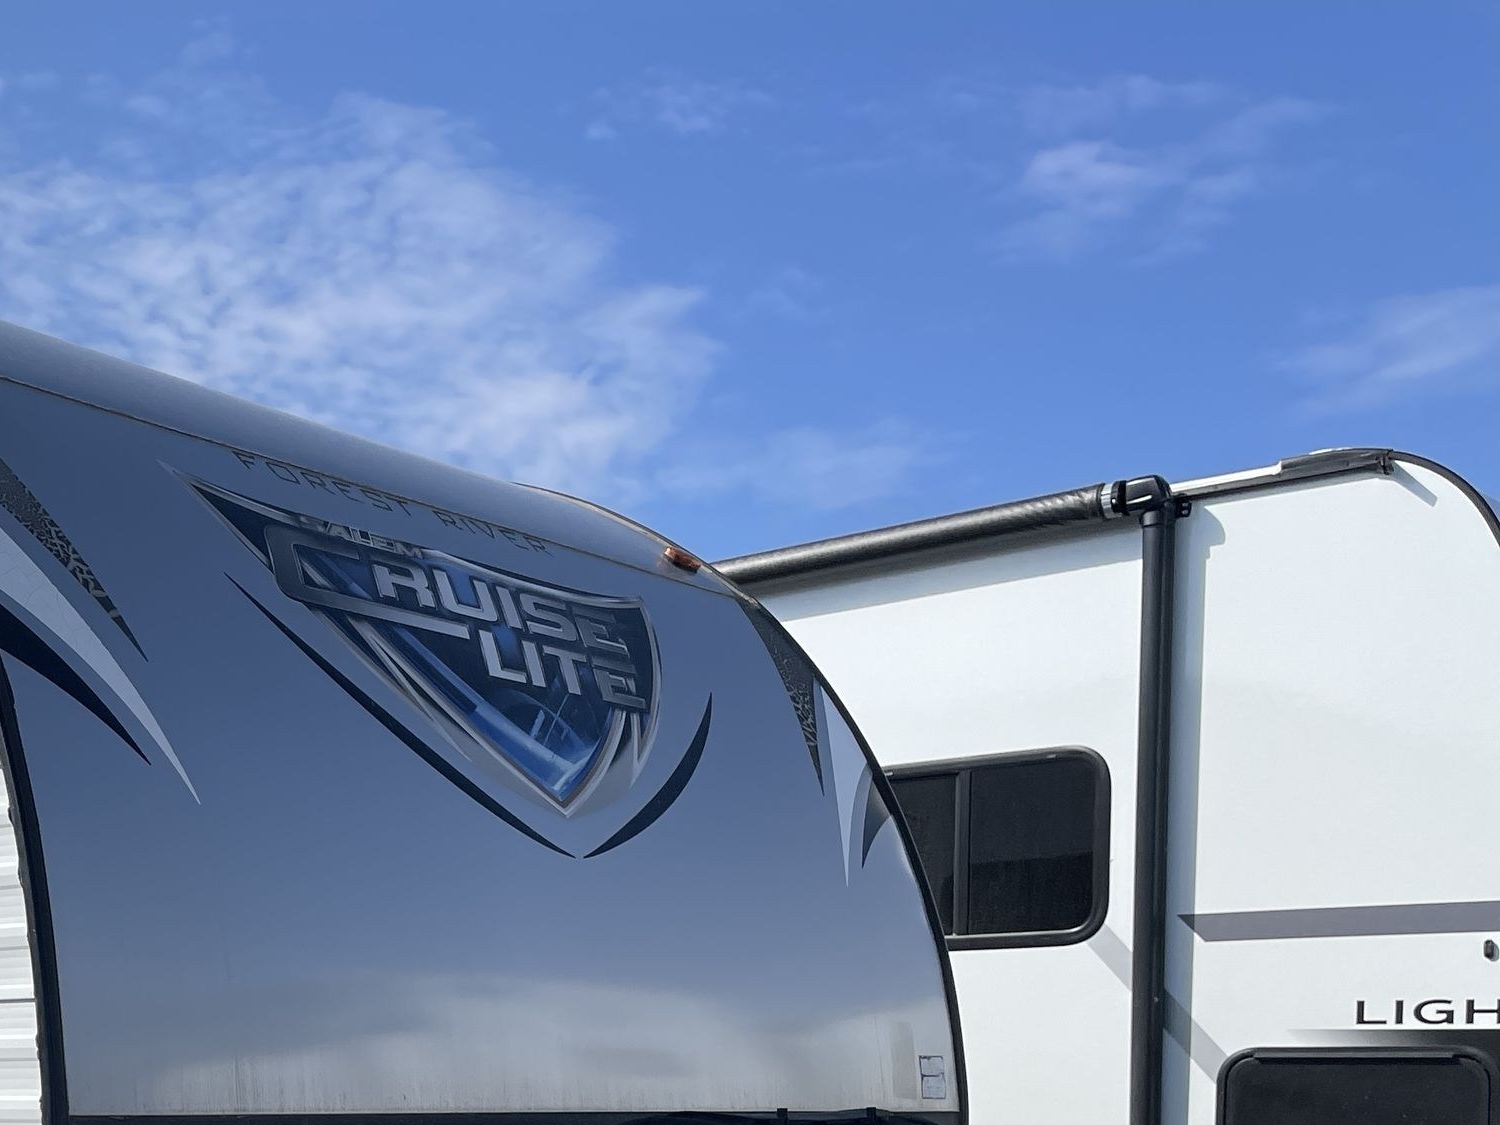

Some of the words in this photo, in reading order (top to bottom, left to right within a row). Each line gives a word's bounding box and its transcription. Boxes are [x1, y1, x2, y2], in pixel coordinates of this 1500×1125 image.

[232, 450, 412, 516] FOREST
[432, 509, 555, 557] RIVER
[300, 515, 424, 559] SALEM
[264, 525, 630, 656] CRUISE
[479, 629, 647, 710] LITE
[1356, 998, 1500, 1025] LIGH
